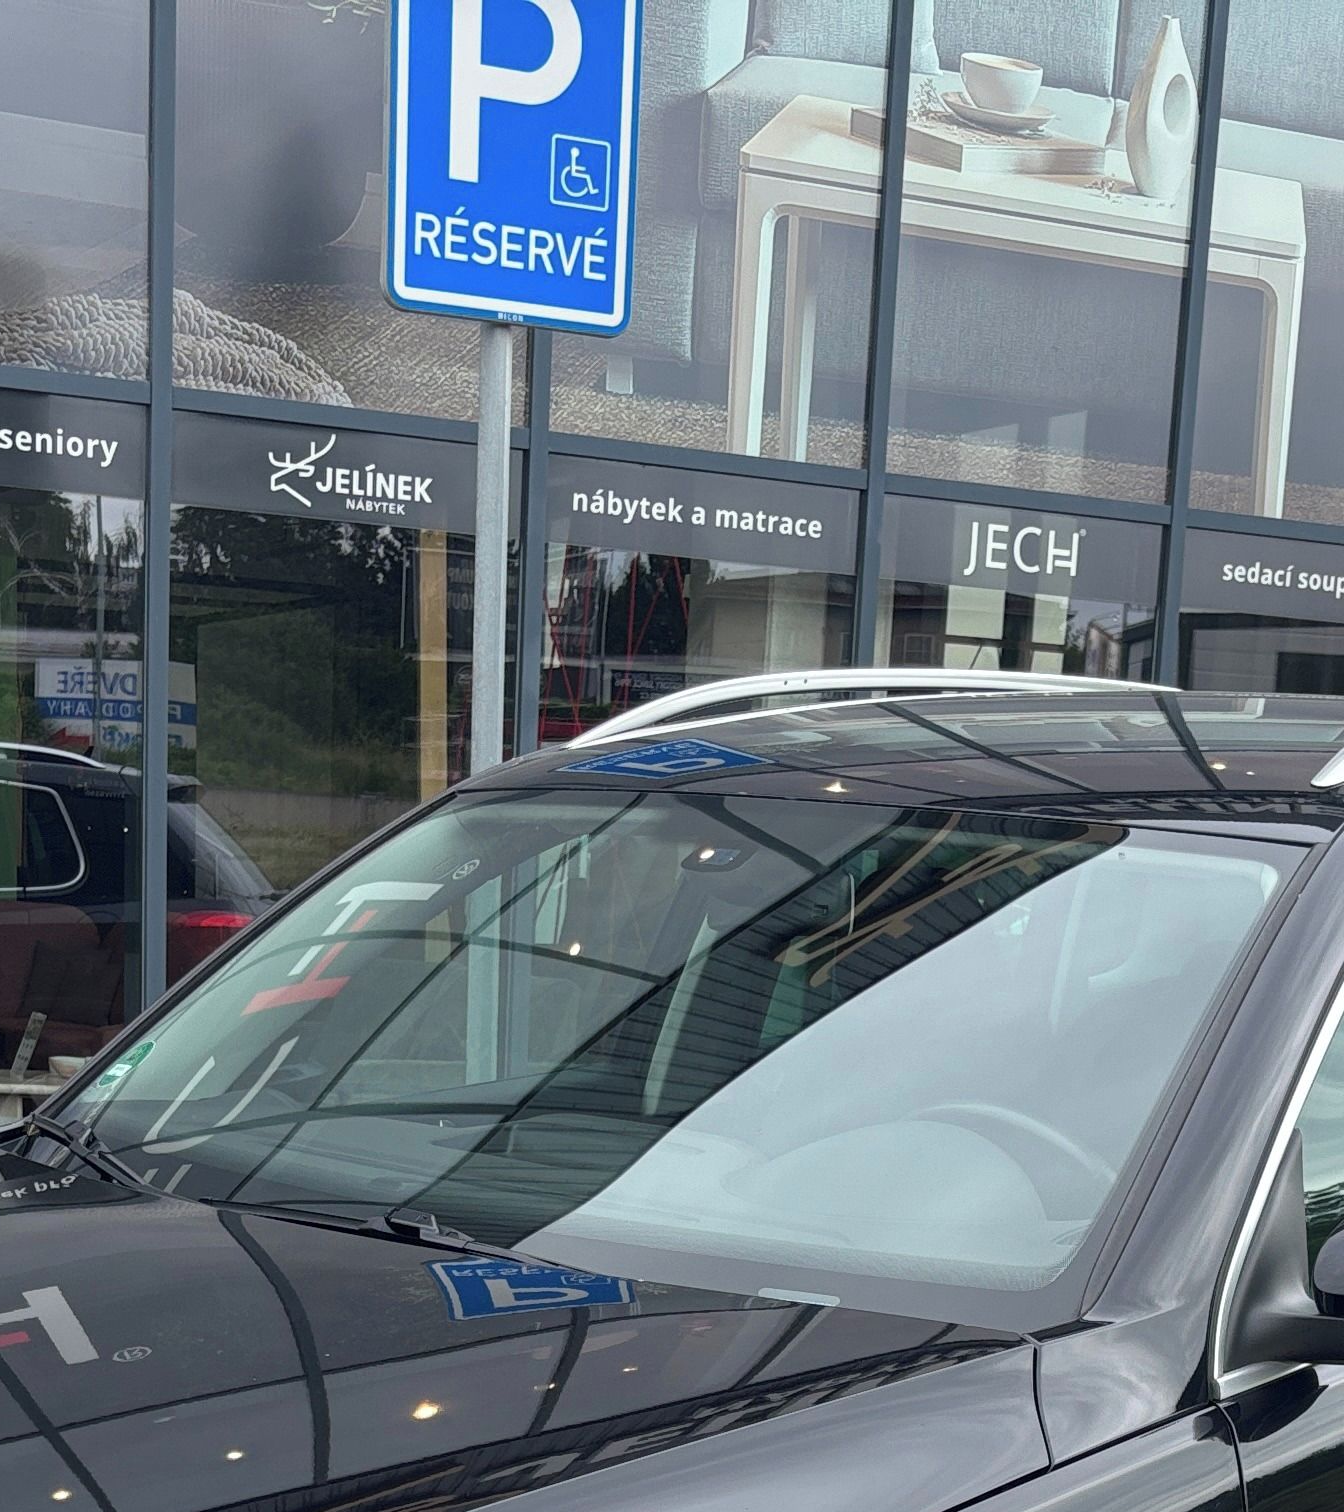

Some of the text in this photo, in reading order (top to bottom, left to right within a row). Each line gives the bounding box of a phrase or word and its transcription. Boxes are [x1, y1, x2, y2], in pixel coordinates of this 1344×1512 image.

[449, 0, 583, 183] P
[414, 206, 608, 281] RÉSERVÉ
[0, 428, 119, 467] seniory
[316, 464, 433, 503] JELÍNEK
[345, 498, 405, 516] NÁBYTEK
[572, 489, 822, 539] nábytek a matrace
[963, 521, 1079, 577] JECH
[1222, 562, 1293, 588] sedací
